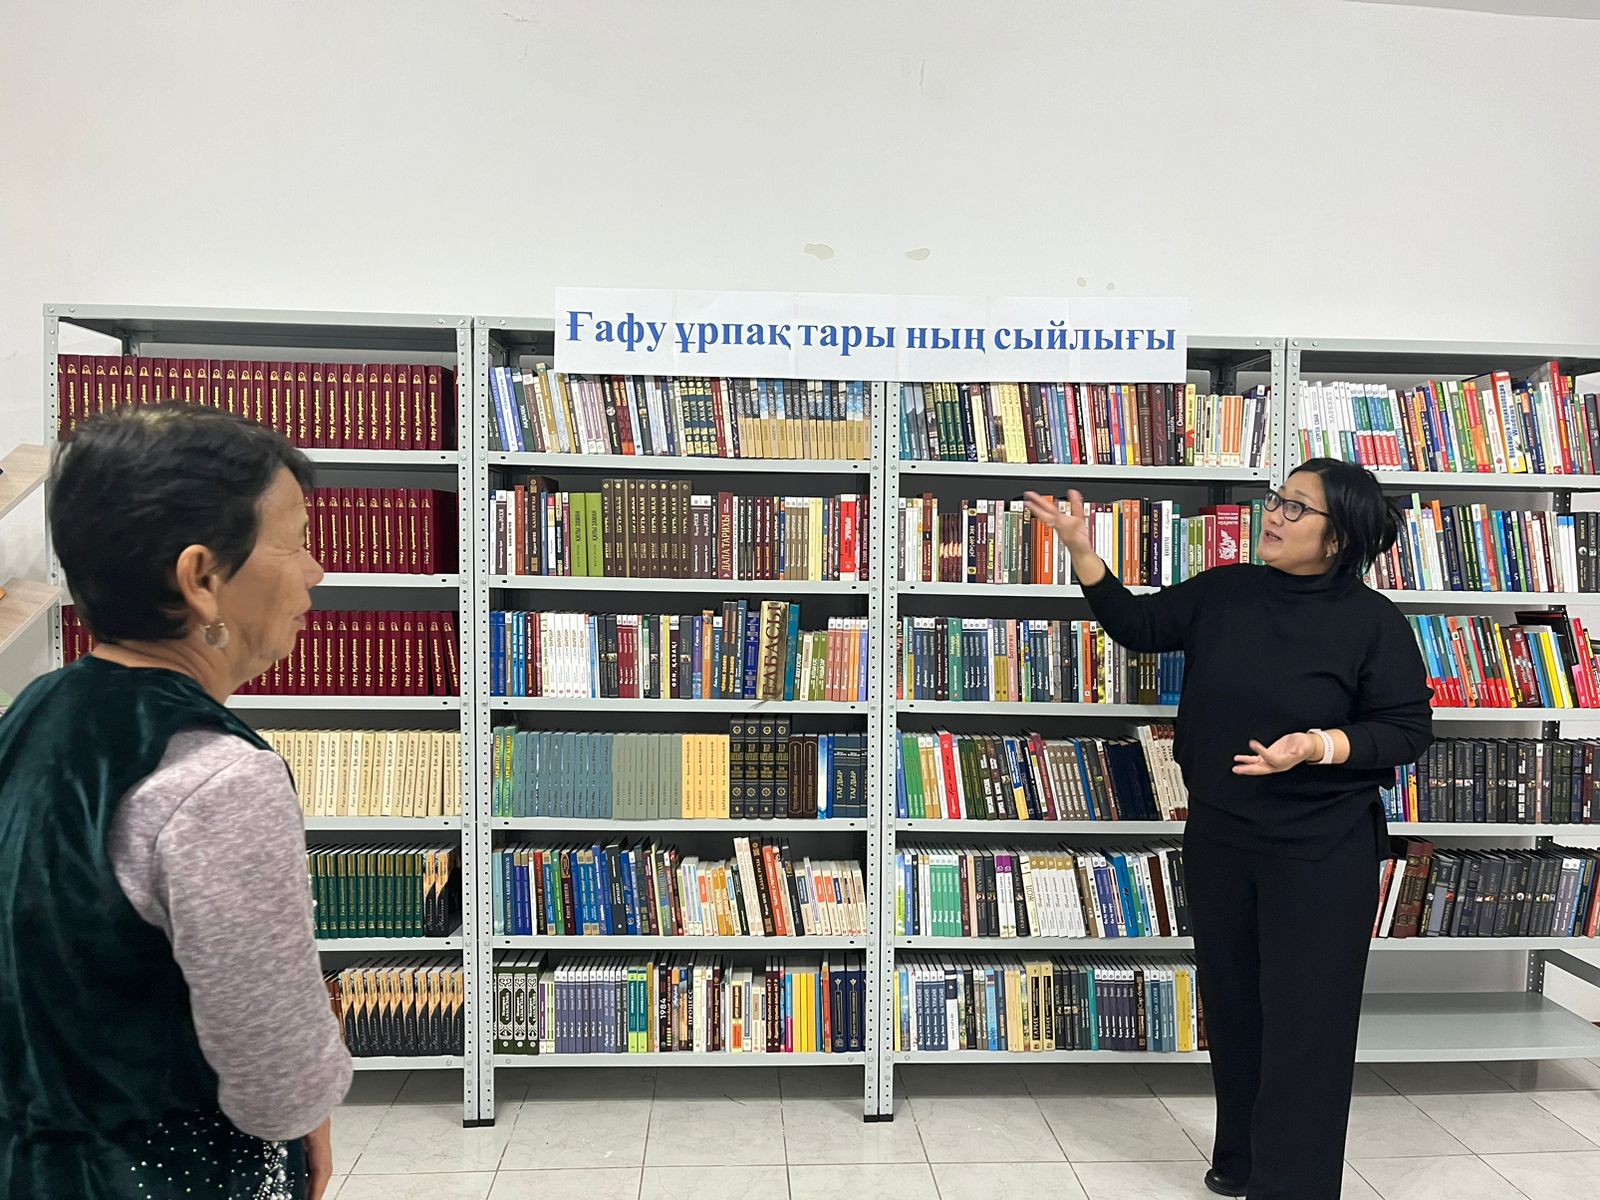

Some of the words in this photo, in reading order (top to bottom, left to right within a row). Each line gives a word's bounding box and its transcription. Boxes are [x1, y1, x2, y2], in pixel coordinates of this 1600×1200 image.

[565, 311, 665, 354] Ғафу
[994, 320, 1177, 352] сыйлығы
[721, 514, 731, 548] ТАРИХЫ
[721, 549, 731, 571] ДАЛА
[762, 604, 782, 696] ЕЛБАСЫ
[1025, 884, 1035, 902] ЖОЛ
[659, 997, 667, 1020] 1984
